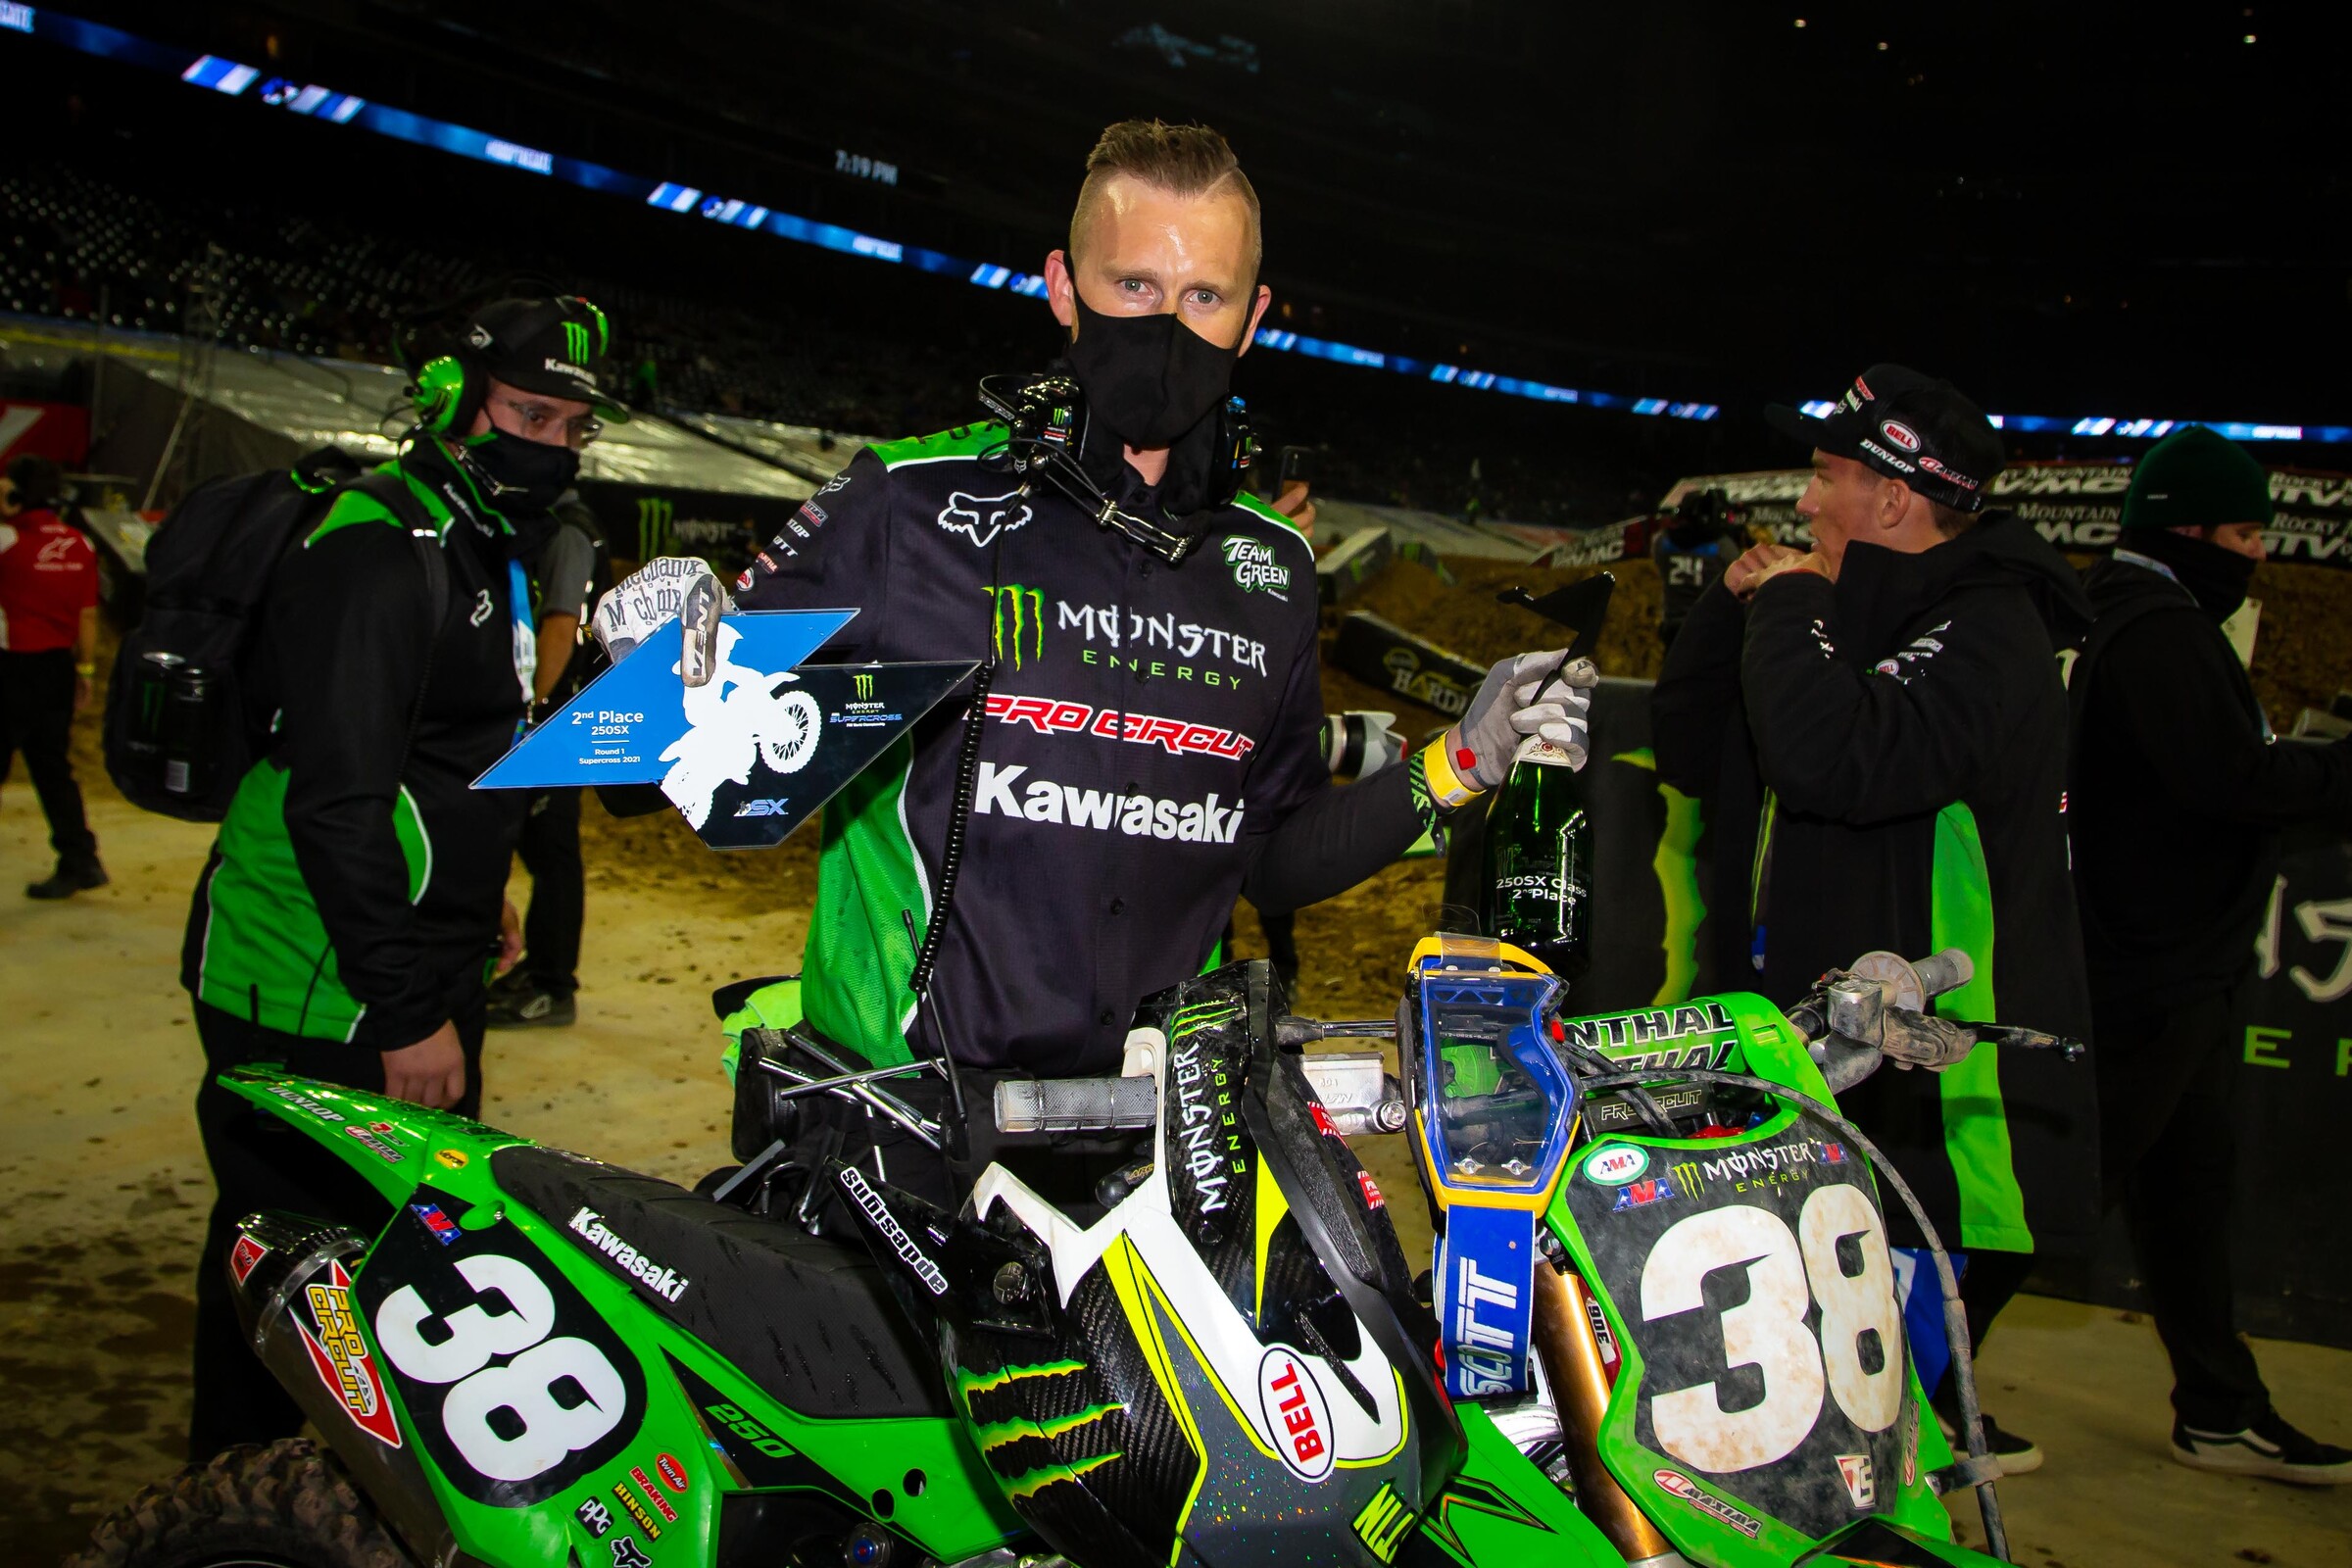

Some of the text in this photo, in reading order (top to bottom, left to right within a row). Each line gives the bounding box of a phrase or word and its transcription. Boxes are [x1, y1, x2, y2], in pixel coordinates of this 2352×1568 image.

[1886, 423, 1913, 448] BELL
[1860, 438, 1915, 473] DUNLOP
[2273, 513, 2339, 535] ROCKY
[1223, 537, 1272, 565] TEAM
[614, 558, 704, 594] Mechanix
[1236, 561, 1288, 588] GREEN
[1669, 556, 1704, 586] 24
[692, 588, 710, 676] VENT
[1055, 600, 1267, 677] MONSTER
[1083, 649, 1242, 690] ENERGY
[571, 710, 644, 725] 2nd Place
[845, 702, 886, 710] MONSTER
[963, 693, 1074, 735] PRO
[591, 725, 629, 736] 250SX
[746, 798, 789, 816] SX
[974, 761, 1245, 843] Kawasaki
[1495, 875, 1587, 898] 250SX Class
[1512, 888, 1577, 905] 2nd Place
[266, 1086, 346, 1122] DUNLOP
[1211, 1057, 1247, 1174] ENERGY
[1173, 1042, 1227, 1214] MONSTER
[1599, 1153, 1636, 1175] AMA
[1702, 1142, 1816, 1182] MONSTER
[1818, 1142, 1850, 1164] AMA
[1613, 1177, 1675, 1213] AMA
[1736, 1169, 1809, 1193] ENERGY
[410, 1202, 462, 1247] AMA
[568, 1206, 689, 1302] Kawasaki
[328, 1290, 367, 1356] PRO
[1456, 1256, 1517, 1396] SCOTT
[1641, 1183, 1901, 1473] 38
[308, 1286, 369, 1414] CIRCUIT
[375, 1254, 626, 1481] 38
[705, 1403, 796, 1457] 250
[1271, 1363, 1325, 1463] BELL
[659, 1456, 686, 1489] Twin Air
[613, 1482, 662, 1540] HINSON
[631, 1468, 677, 1522] BRAKING
[1682, 1488, 1761, 1533] MAXIMA
[579, 1499, 612, 1534] PPG
